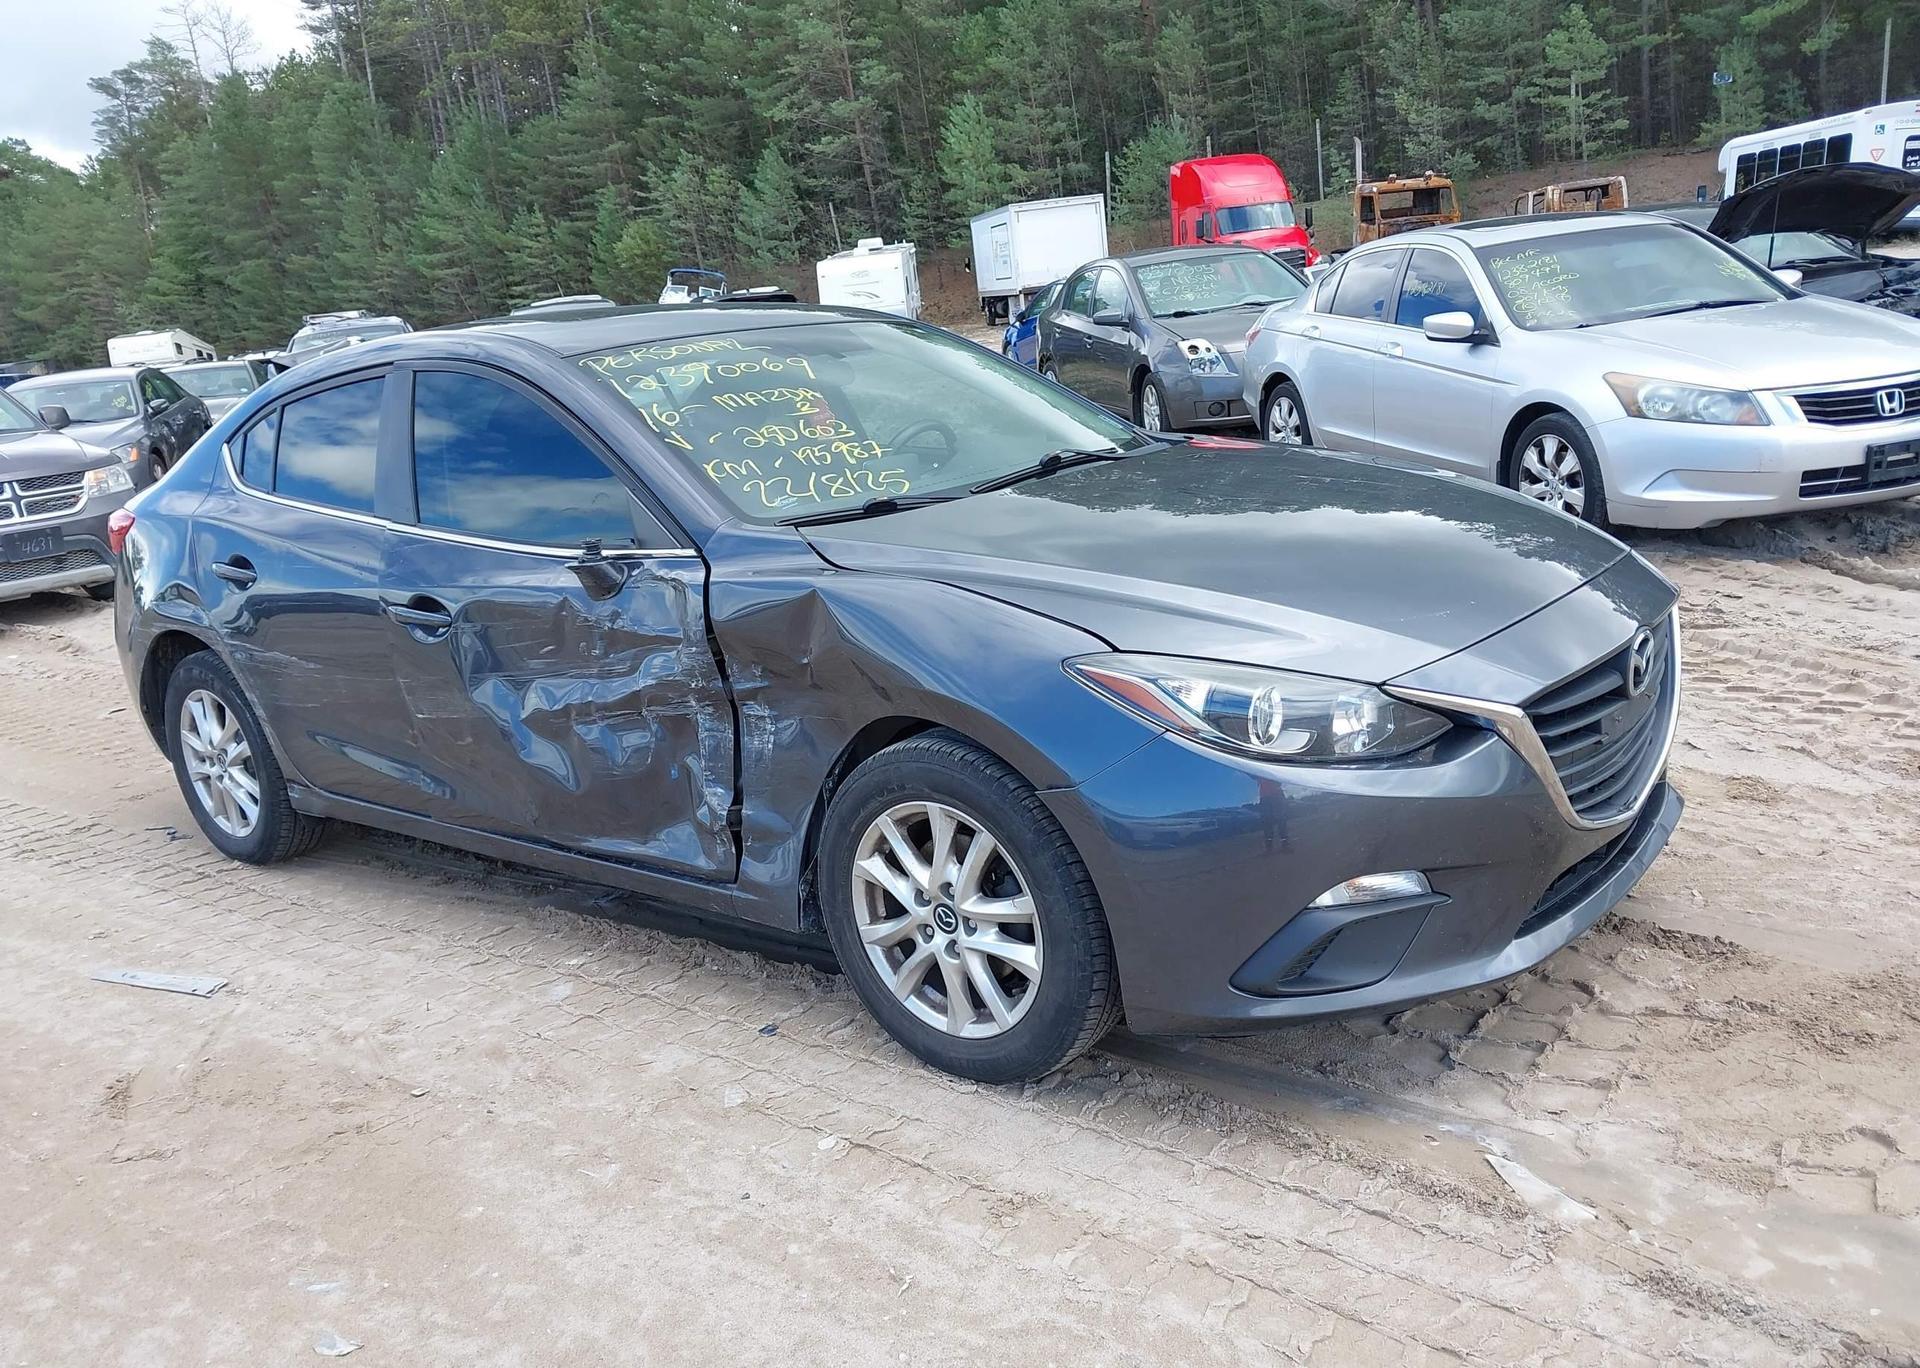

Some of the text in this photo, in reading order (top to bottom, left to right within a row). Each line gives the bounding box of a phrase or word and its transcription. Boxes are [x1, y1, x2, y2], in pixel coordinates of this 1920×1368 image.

[1532, 273, 1579, 289] ACCORD
[579, 339, 772, 377] PERSONAL
[610, 357, 816, 399] 12390069
[712, 391, 824, 412] MAZDA
[733, 420, 855, 448] 250603
[703, 459, 762, 484] KM
[791, 441, 893, 466] 195987
